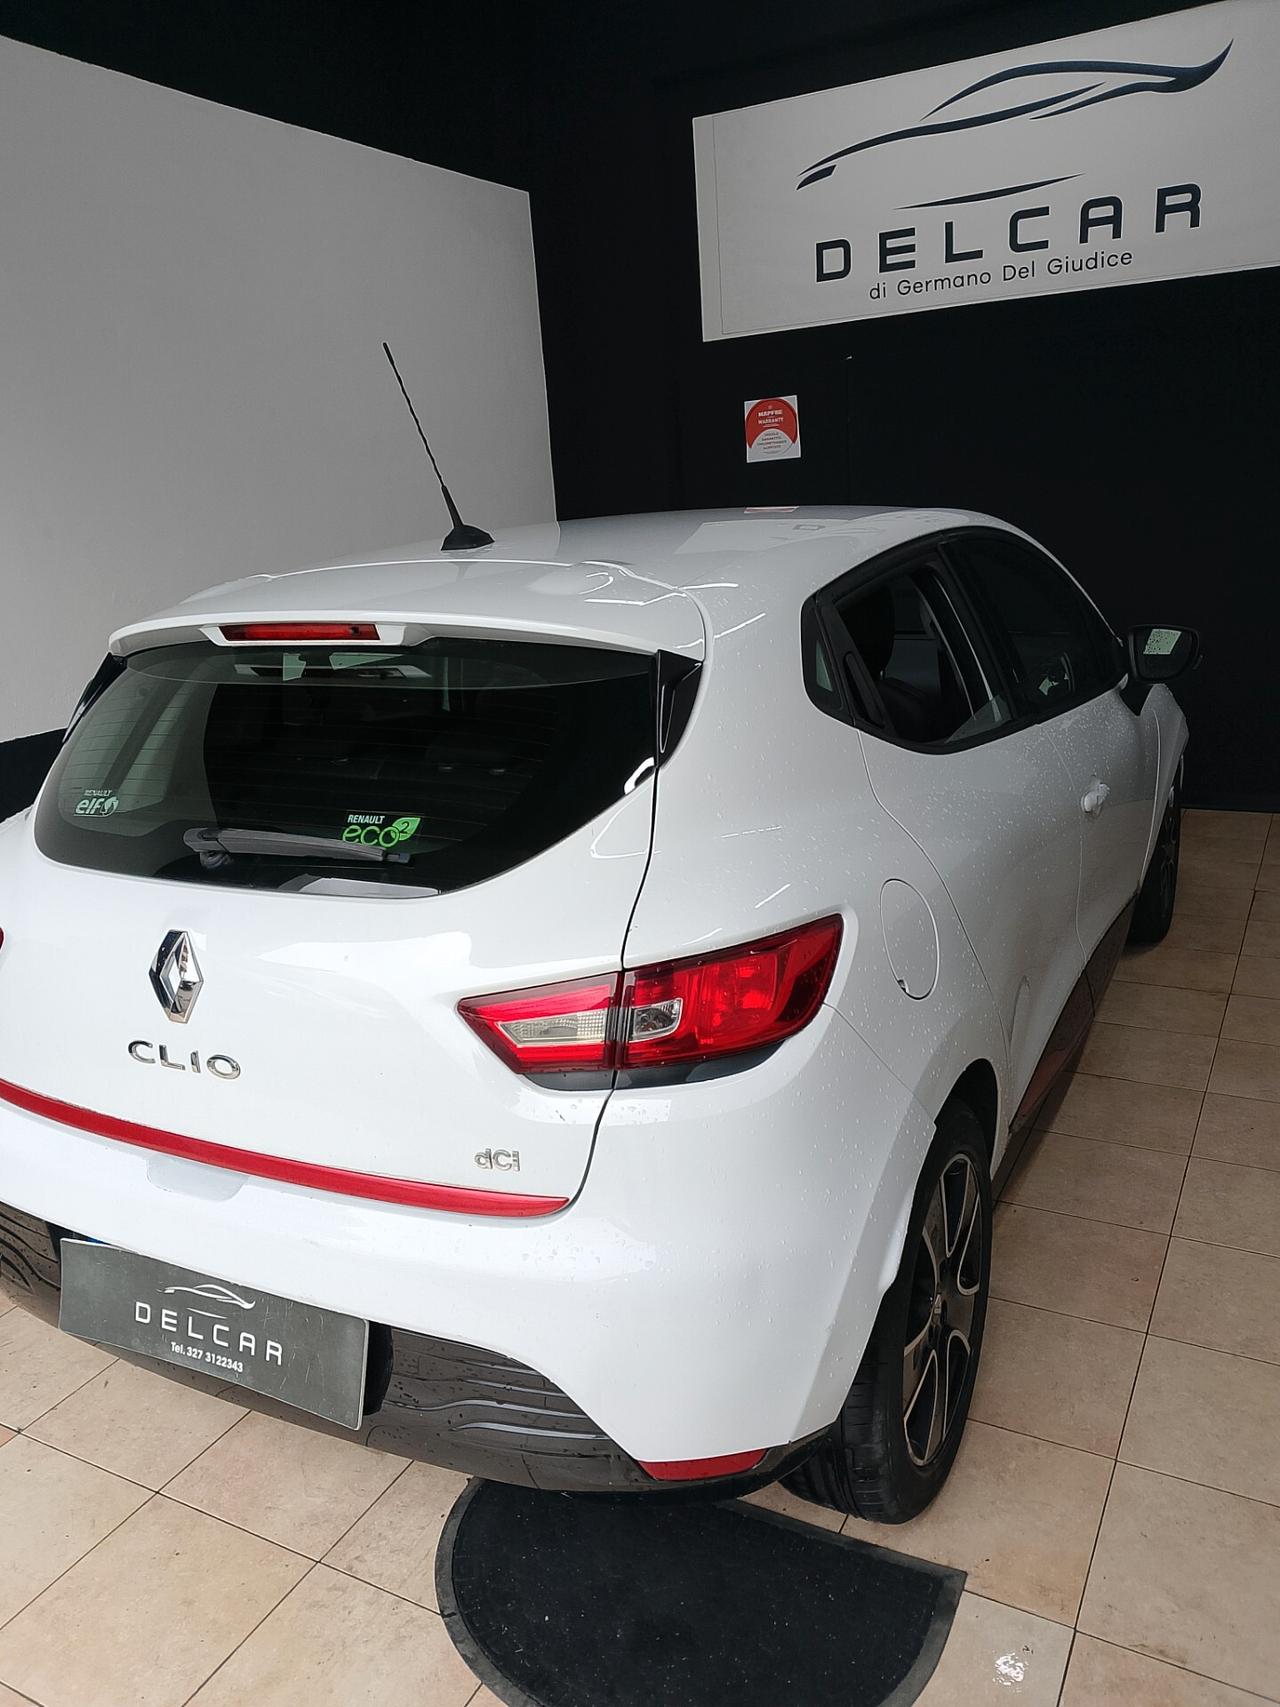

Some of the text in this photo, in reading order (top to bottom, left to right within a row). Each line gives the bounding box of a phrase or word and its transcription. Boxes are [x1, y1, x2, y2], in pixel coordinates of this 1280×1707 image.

[816, 183, 1201, 283] DELCAR
[869, 250, 1133, 300] di Germano Del Giudice
[347, 814, 385, 825] RENAULT
[127, 1040, 241, 1080] CLIO
[135, 1301, 283, 1366] DELCAR
[170, 1341, 244, 1373] Tel. 327 3122343
